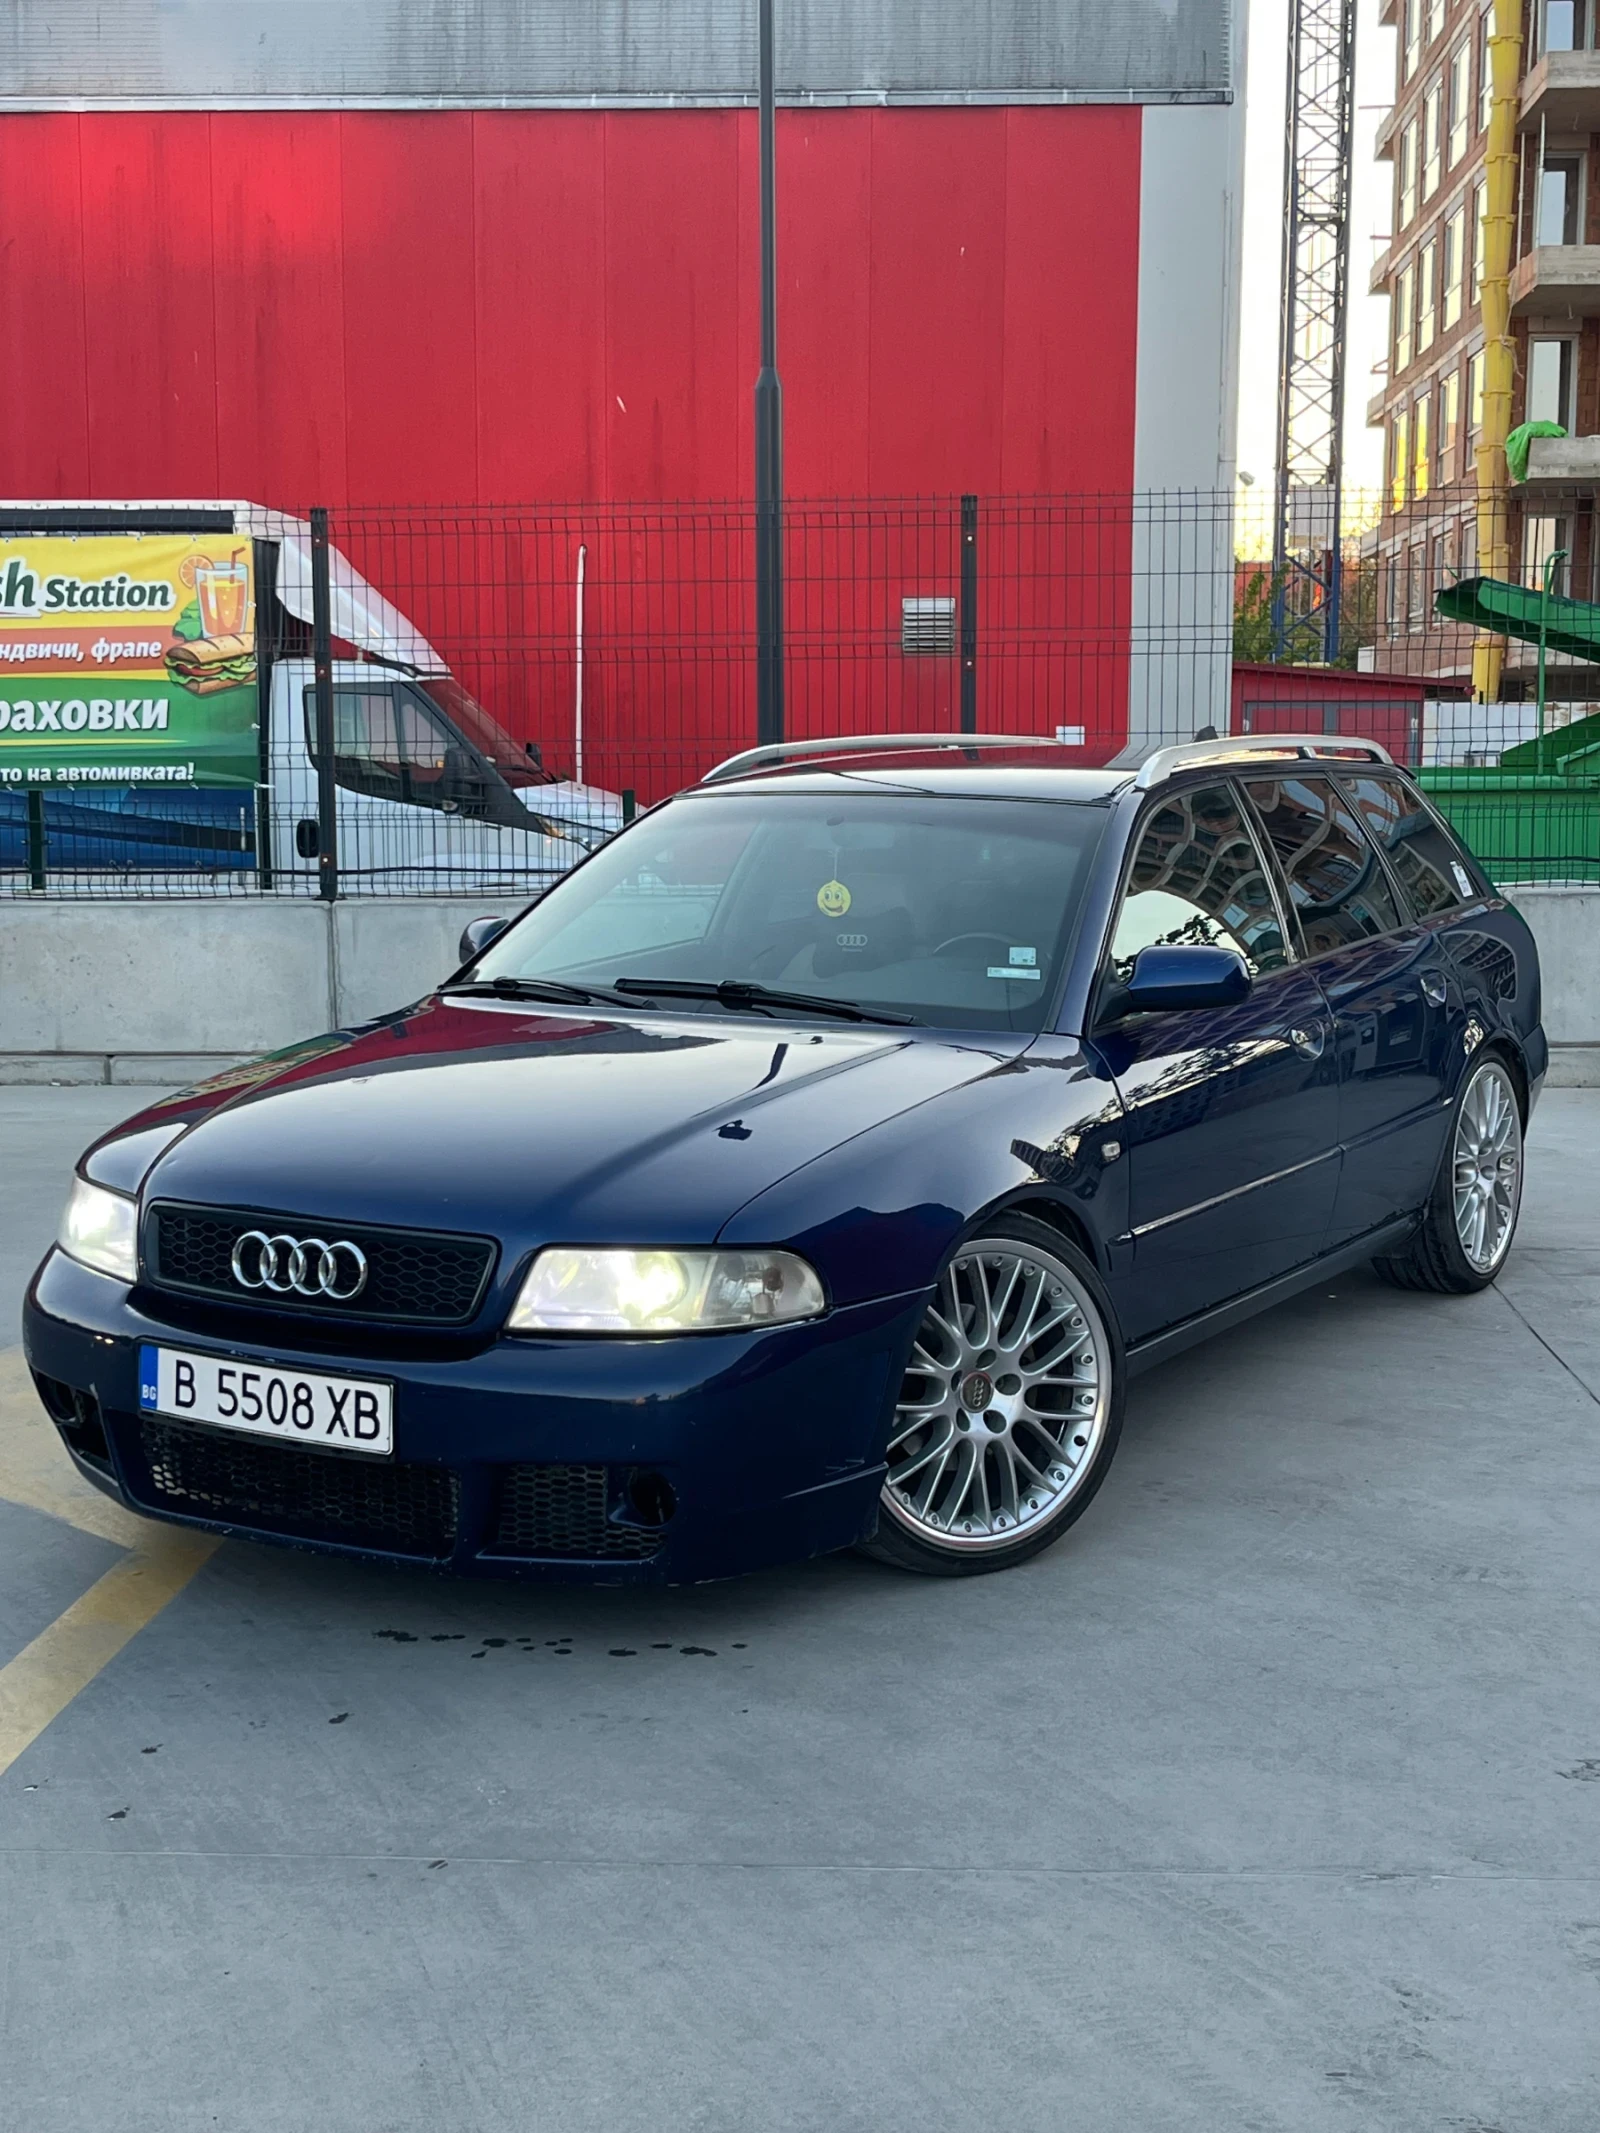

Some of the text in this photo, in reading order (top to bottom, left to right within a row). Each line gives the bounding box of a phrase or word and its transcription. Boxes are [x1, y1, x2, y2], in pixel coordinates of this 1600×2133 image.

[0, 561, 170, 607] h Station
[91, 637, 162, 663] фрапе
[27, 767, 52, 781] на
[56, 762, 193, 782] автомивката!
[142, 1384, 157, 1400] BG
[175, 1359, 381, 1440] B 5508 XB
